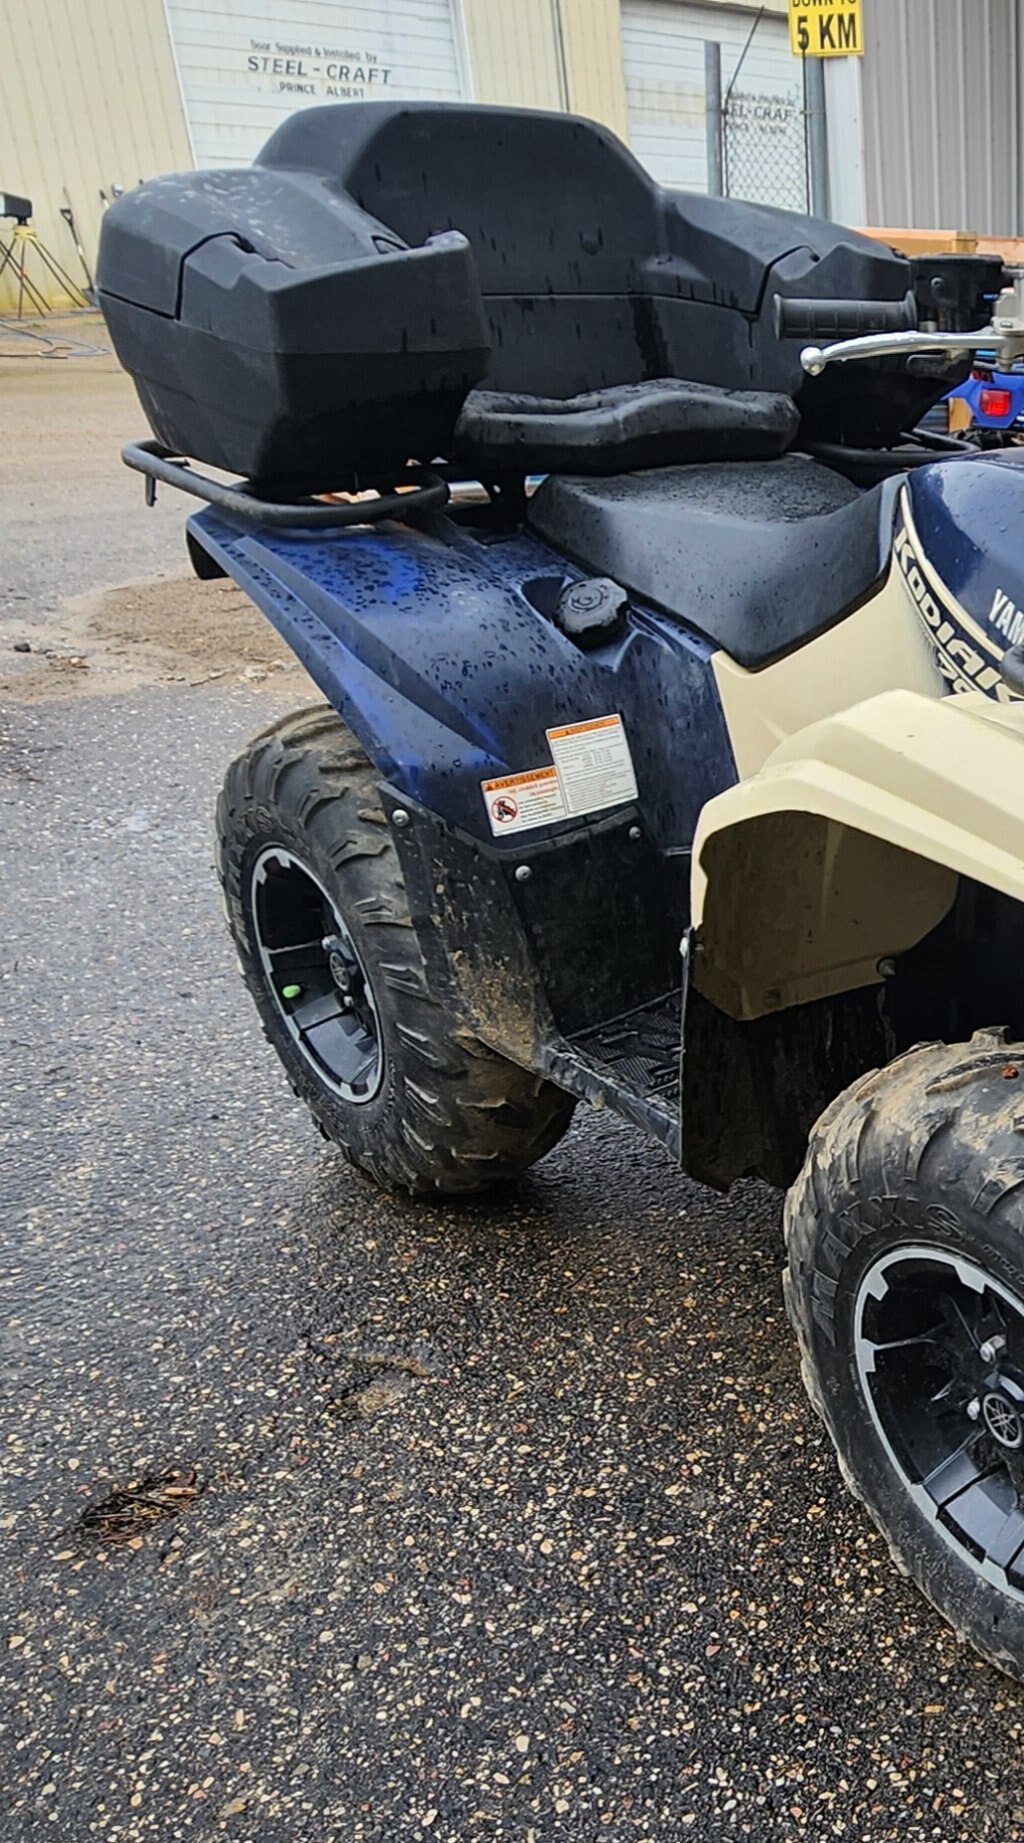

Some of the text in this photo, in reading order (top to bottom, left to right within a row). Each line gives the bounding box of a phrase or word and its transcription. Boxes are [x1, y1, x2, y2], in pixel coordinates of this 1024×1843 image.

[797, 12, 857, 51] 5 KM
[279, 81, 365, 99] PRINCE ALBERT
